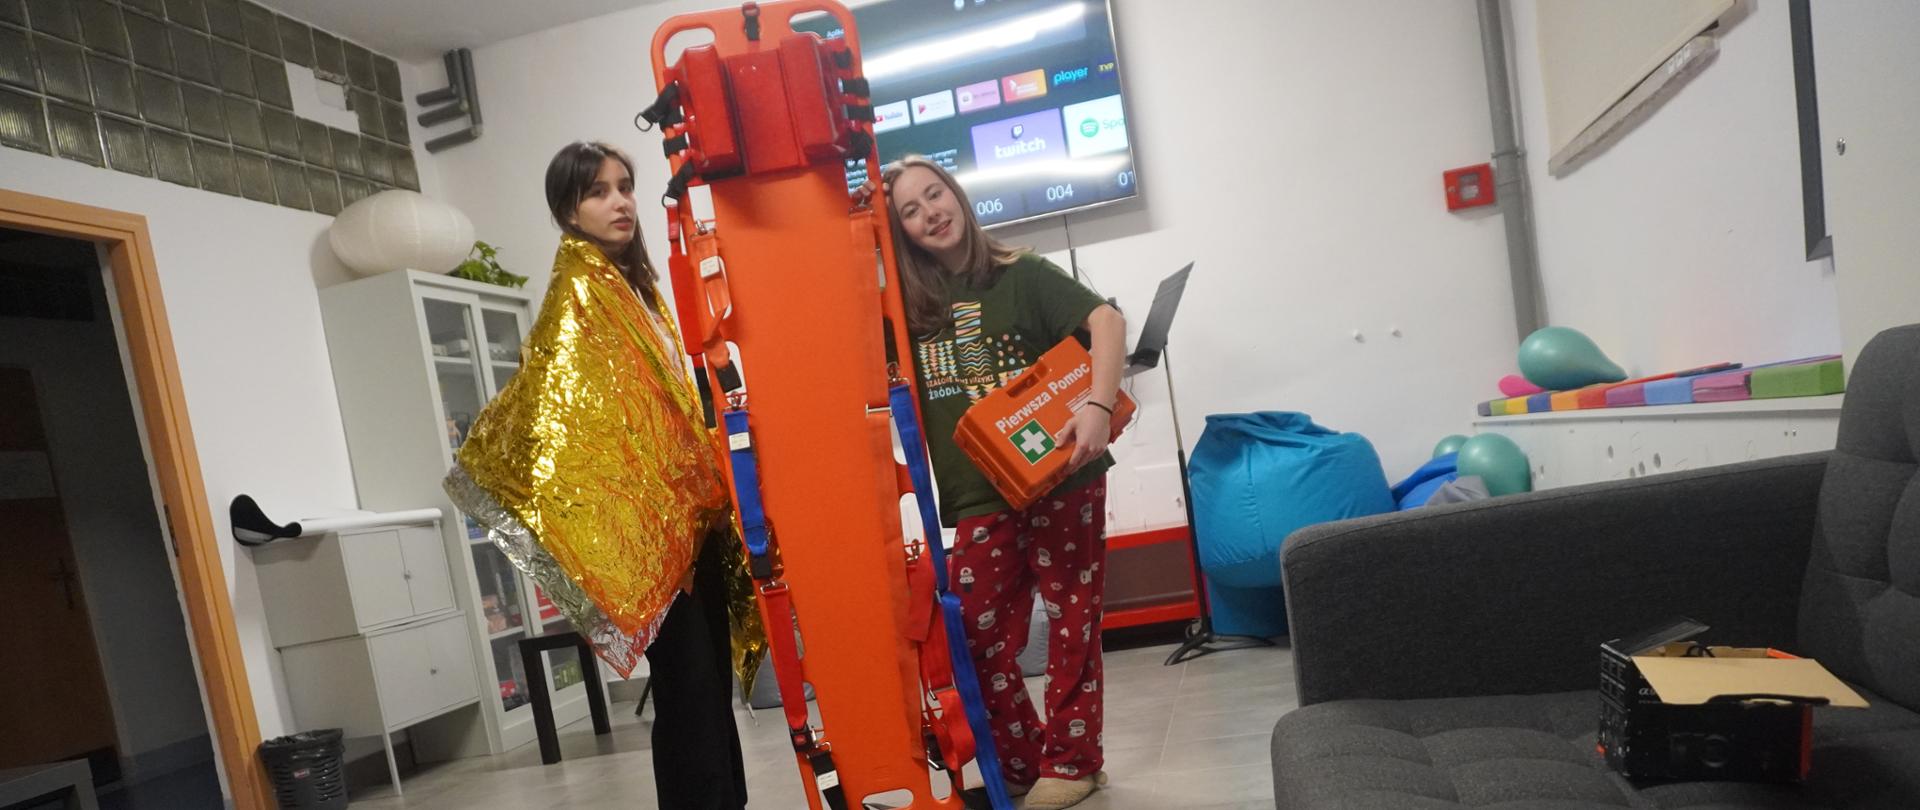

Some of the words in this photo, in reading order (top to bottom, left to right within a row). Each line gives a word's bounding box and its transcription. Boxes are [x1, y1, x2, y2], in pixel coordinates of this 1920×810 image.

[1053, 66, 1089, 86] player
[994, 137, 1046, 159] twitch
[1046, 183, 1074, 201] 004
[976, 198, 1003, 215] 006
[995, 391, 1052, 434] Pierwsza
[1047, 362, 1090, 395] Pomoc
